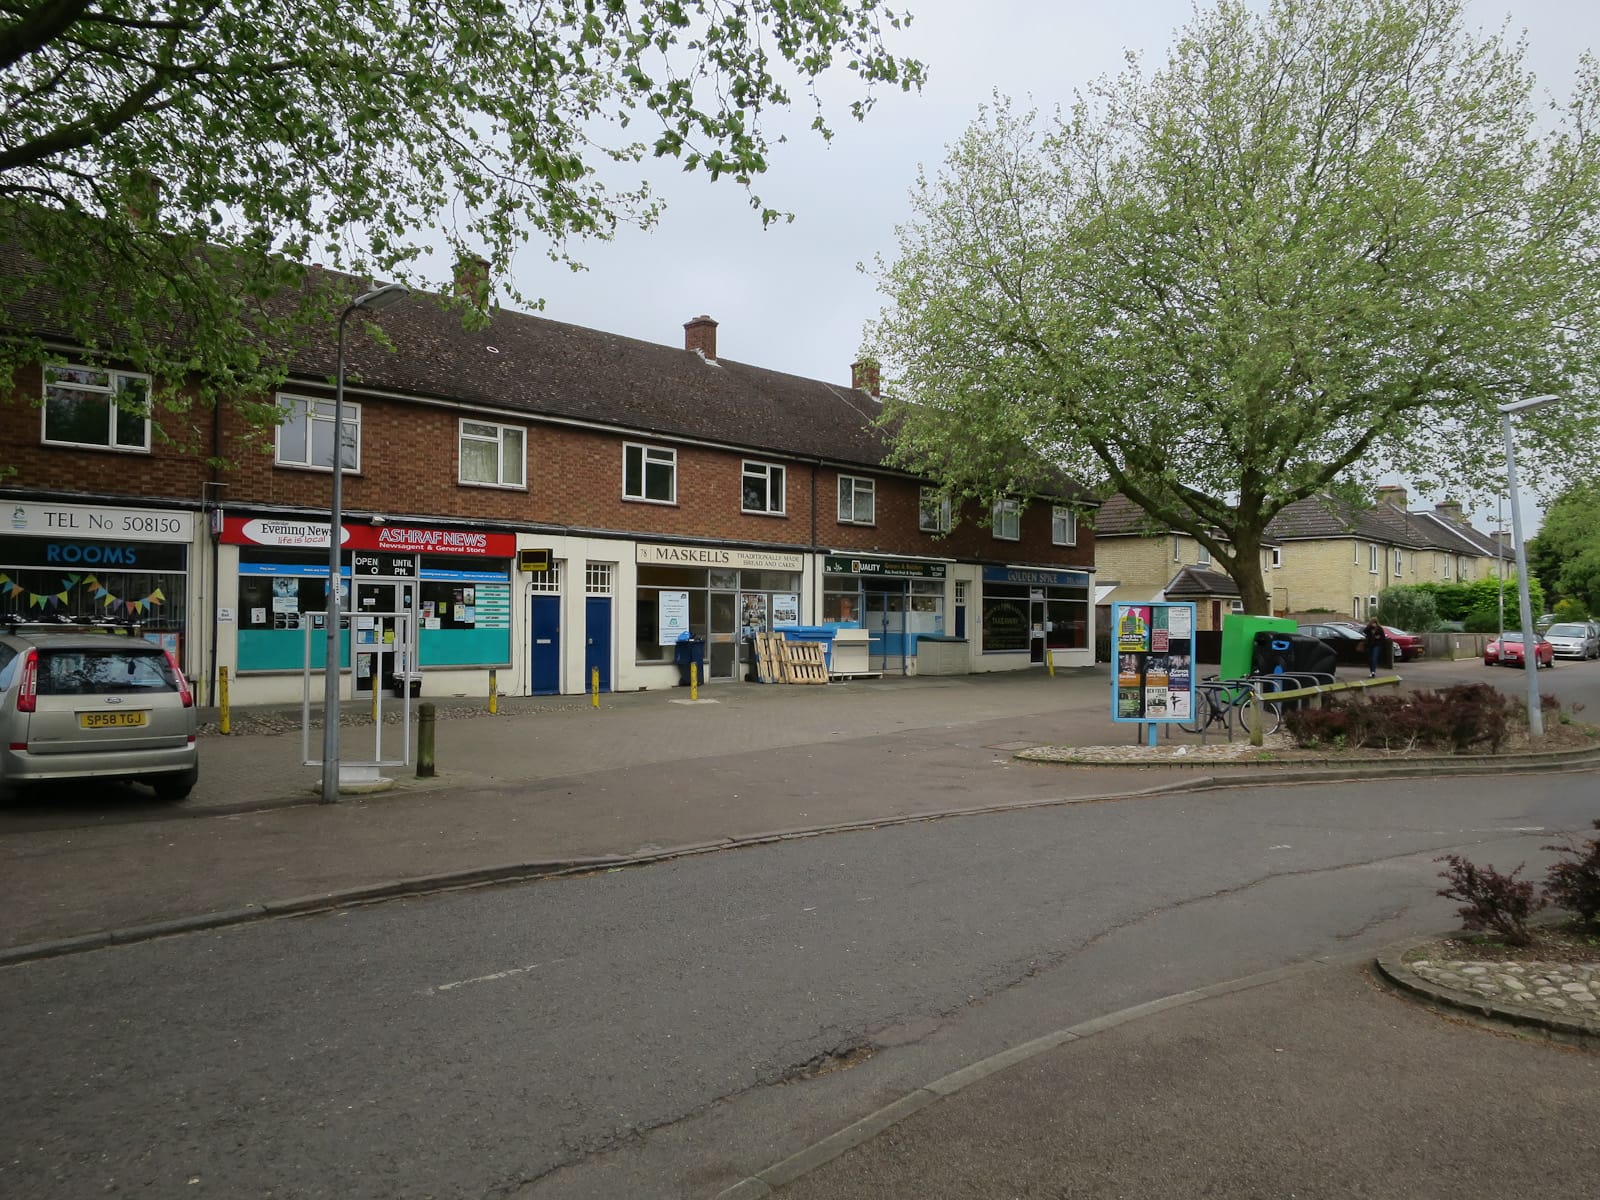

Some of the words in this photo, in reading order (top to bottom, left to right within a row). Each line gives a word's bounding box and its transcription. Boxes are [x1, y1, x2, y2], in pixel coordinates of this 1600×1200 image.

[43, 512, 79, 528] TEL
[89, 514, 113, 530] No
[122, 516, 181, 533] 508150
[261, 523, 305, 538] Evening
[378, 527, 442, 545] ASHRAF
[443, 533, 486, 548] NEWS
[379, 542, 424, 551] Newsagent
[47, 544, 137, 565] ROOMS
[640, 548, 648, 558] 78
[737, 552, 782, 561] TRADITIONALLY
[783, 554, 800, 563] MADE
[355, 557, 378, 567] OPEN
[392, 558, 413, 568] UNTIL
[743, 559, 763, 567] BREAD
[764, 560, 777, 568] AND
[778, 561, 796, 569] CAKES
[851, 560, 880, 573] QUALITY
[1007, 570, 1037, 583] GOLDEN
[1039, 573, 1058, 584] SPICE
[87, 715, 117, 726] SP58
[120, 714, 141, 724] TGJ
